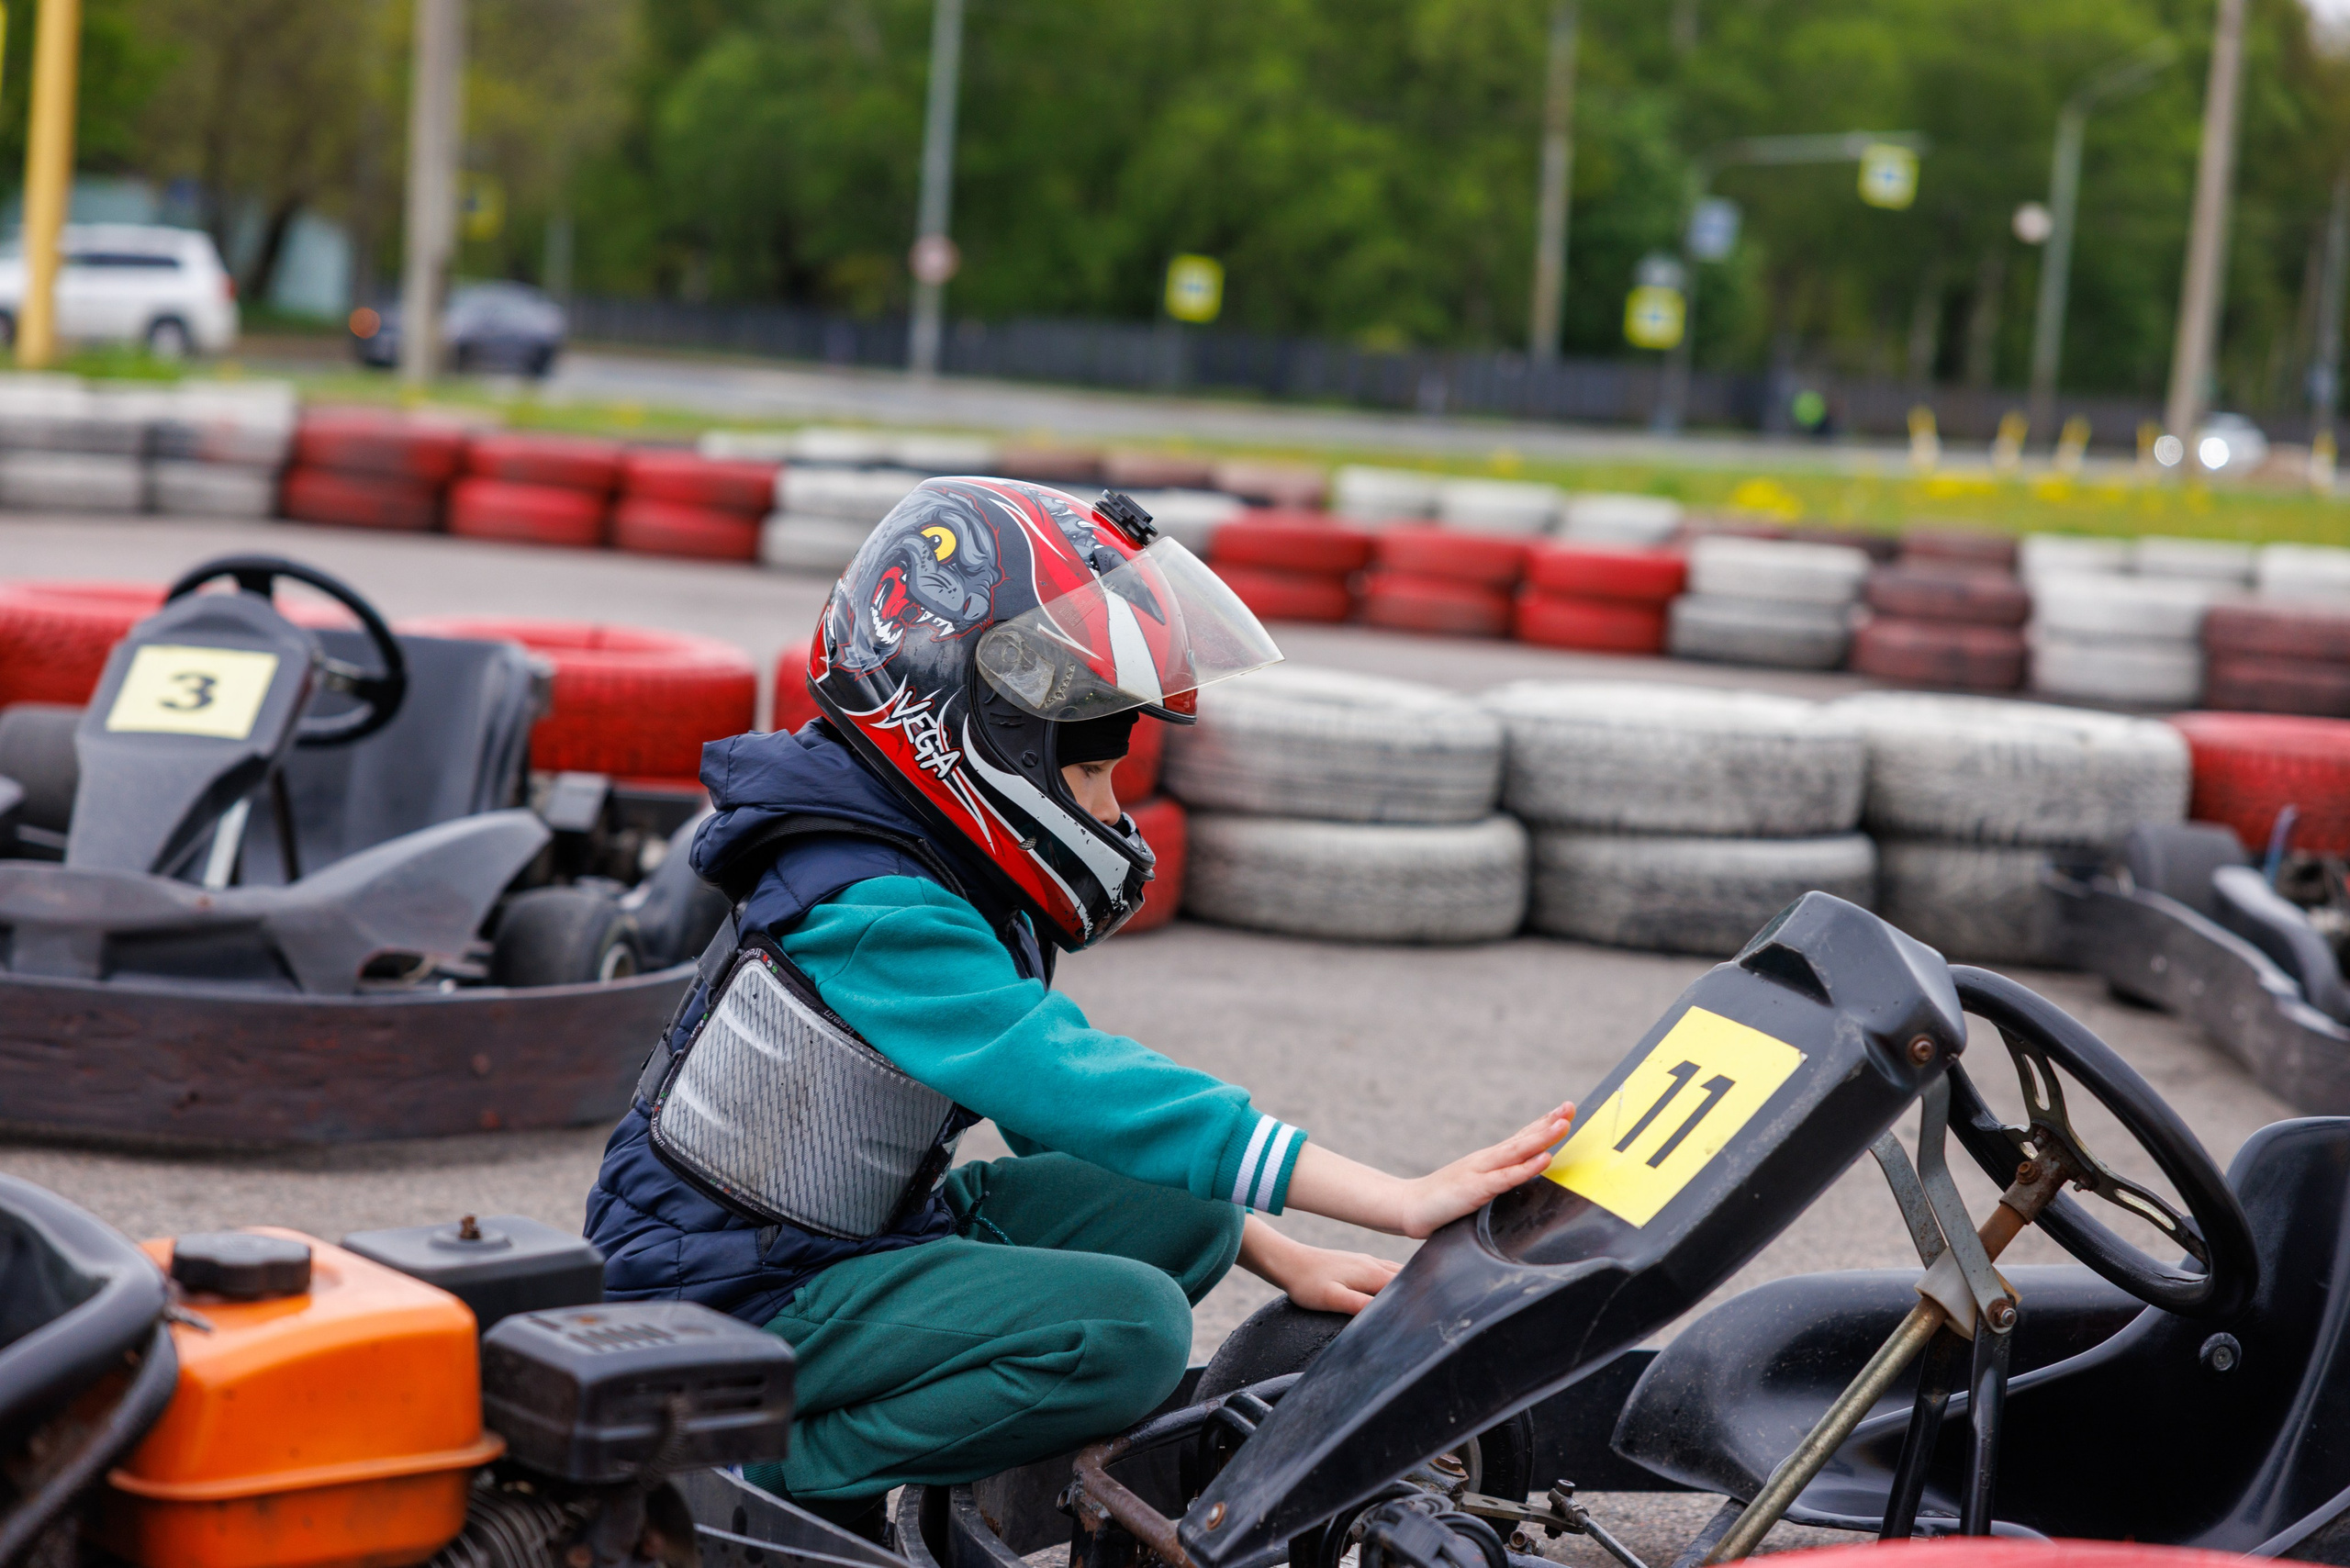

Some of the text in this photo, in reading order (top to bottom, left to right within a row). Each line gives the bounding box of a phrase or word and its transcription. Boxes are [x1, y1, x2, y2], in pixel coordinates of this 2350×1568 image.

[158, 671, 218, 712] 3
[890, 689, 962, 778] VEGA
[1612, 1060, 1736, 1169] 11
